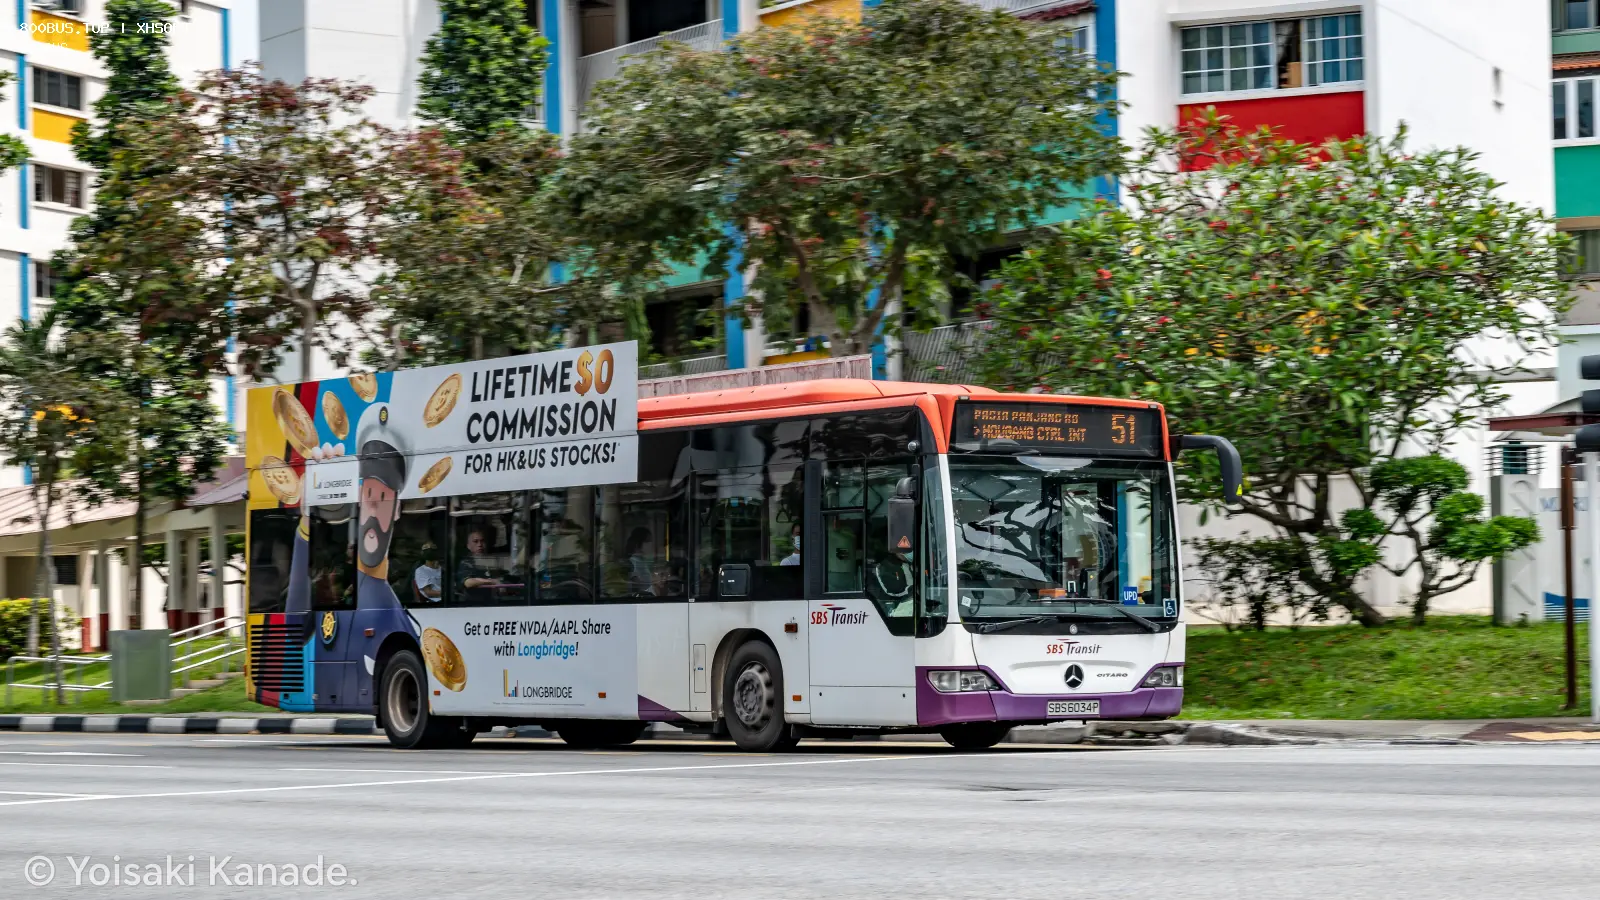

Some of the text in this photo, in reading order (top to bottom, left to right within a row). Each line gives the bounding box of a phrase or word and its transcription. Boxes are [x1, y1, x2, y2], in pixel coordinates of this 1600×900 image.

[471, 349, 614, 403] LIFETIME $0
[466, 398, 617, 444] COMMISSION
[974, 409, 1008, 421] PASIR
[1011, 411, 1061, 423] PANJANG
[1037, 427, 1065, 441] CTRL
[1068, 428, 1086, 442] INT
[1111, 414, 1136, 444] 51
[464, 441, 617, 475] FOR HK&US STOCKS!
[1124, 591, 1138, 602] UPD
[810, 606, 869, 627] SBS Transit
[464, 618, 611, 637] Get a FREE NVDA/AAPL Share
[493, 640, 579, 660] with Longbridge!
[1046, 641, 1102, 656] SBS Transit
[522, 686, 573, 699] LONGBRIDGE
[1048, 702, 1099, 713] SBS6034P
